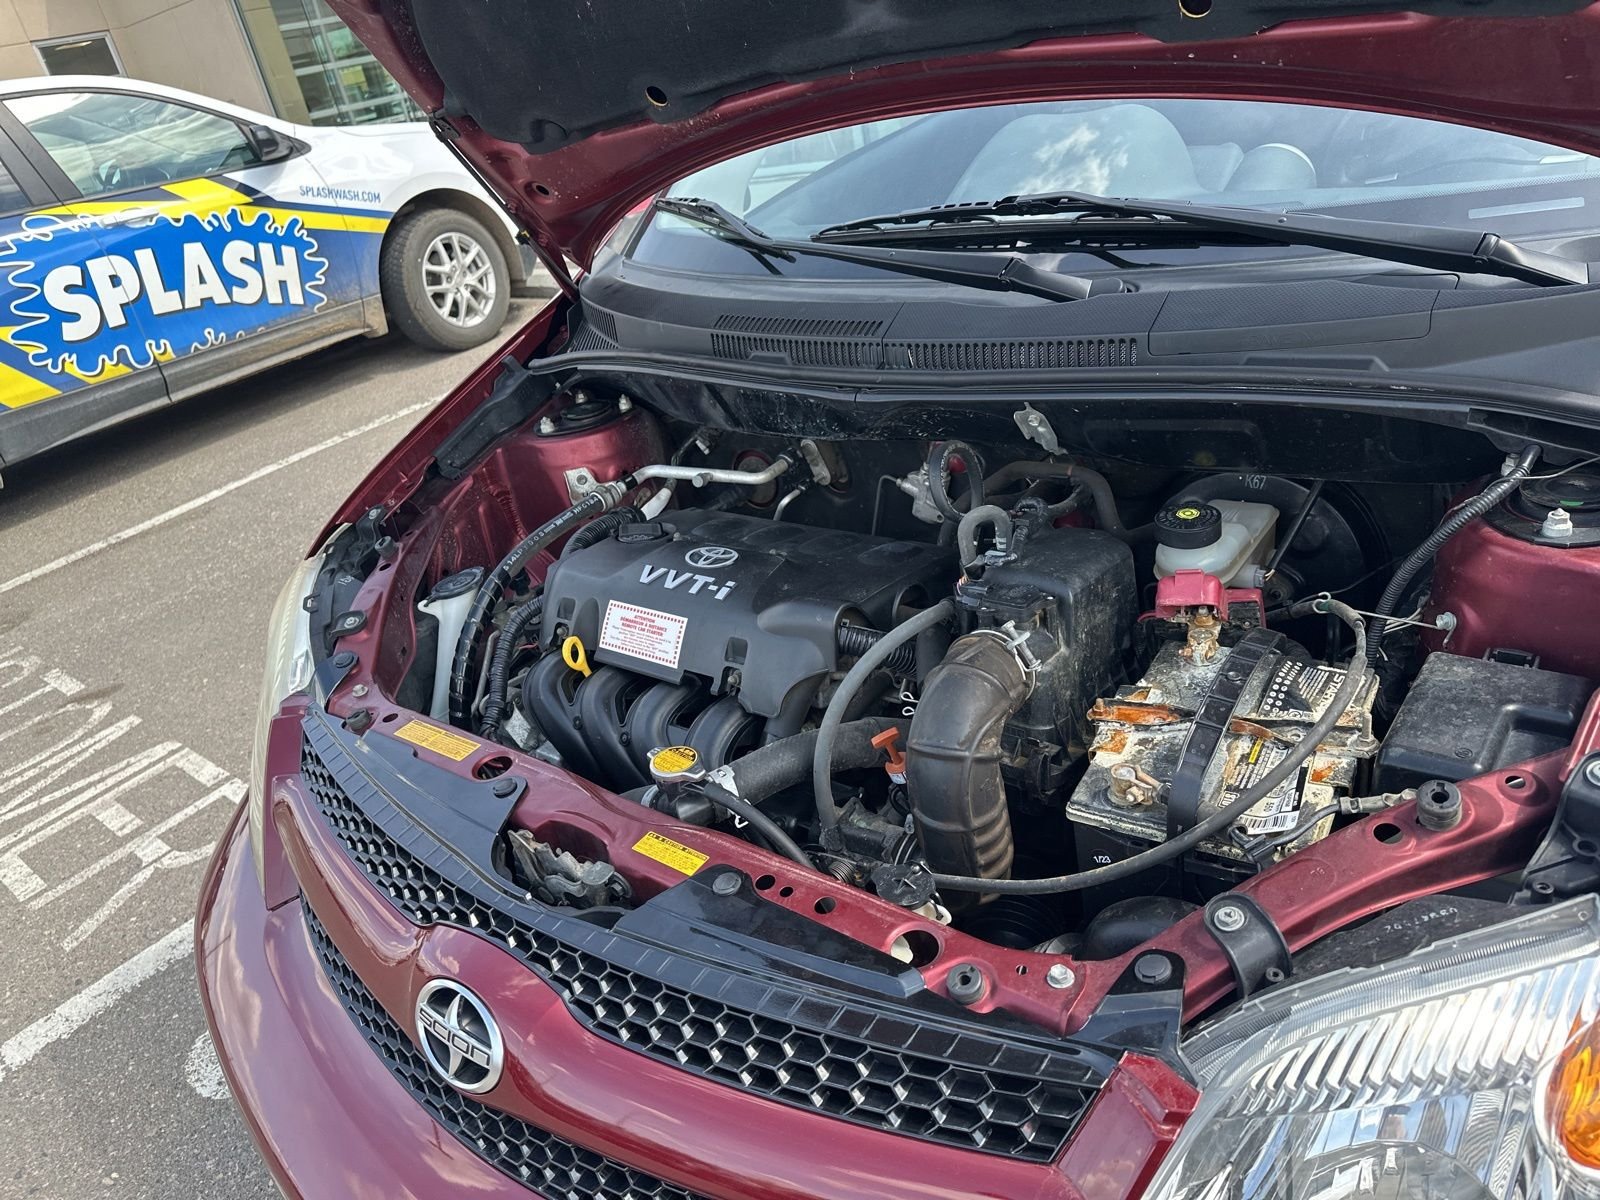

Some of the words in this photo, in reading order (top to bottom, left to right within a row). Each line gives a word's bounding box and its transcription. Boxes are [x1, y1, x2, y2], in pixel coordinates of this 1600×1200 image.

[299, 185, 381, 203] SPLASHWASH.COM
[43, 239, 305, 343] SPLASH
[639, 564, 736, 601] VVT-i
[634, 615, 655, 623] ATTENTION
